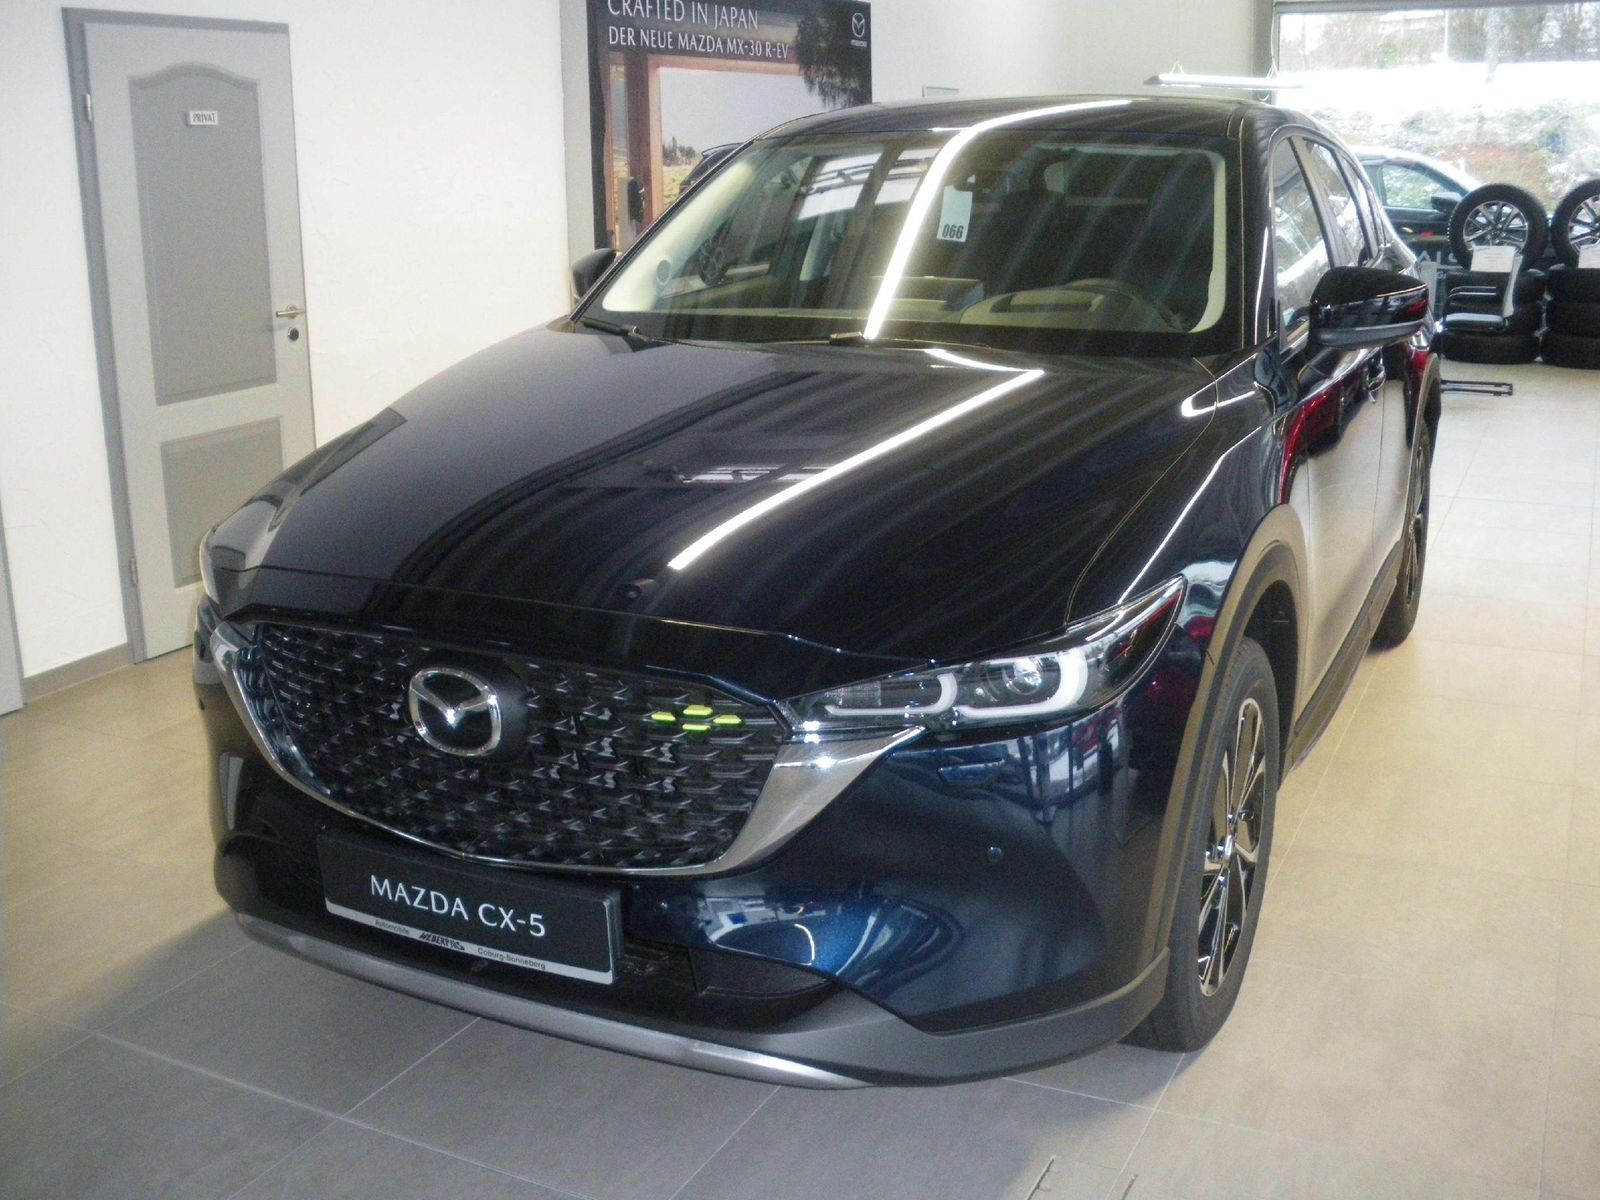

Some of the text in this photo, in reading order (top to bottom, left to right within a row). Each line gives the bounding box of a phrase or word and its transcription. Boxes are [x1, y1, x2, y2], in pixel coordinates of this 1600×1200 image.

[608, 0, 758, 30] CRAFTED IN JAPAN
[609, 26, 789, 59] DER NEUE MAZDA MX-30 R-EV
[192, 112, 216, 123] PRIVAT
[942, 224, 964, 240] 066
[370, 874, 546, 937] MAZDA CX-5
